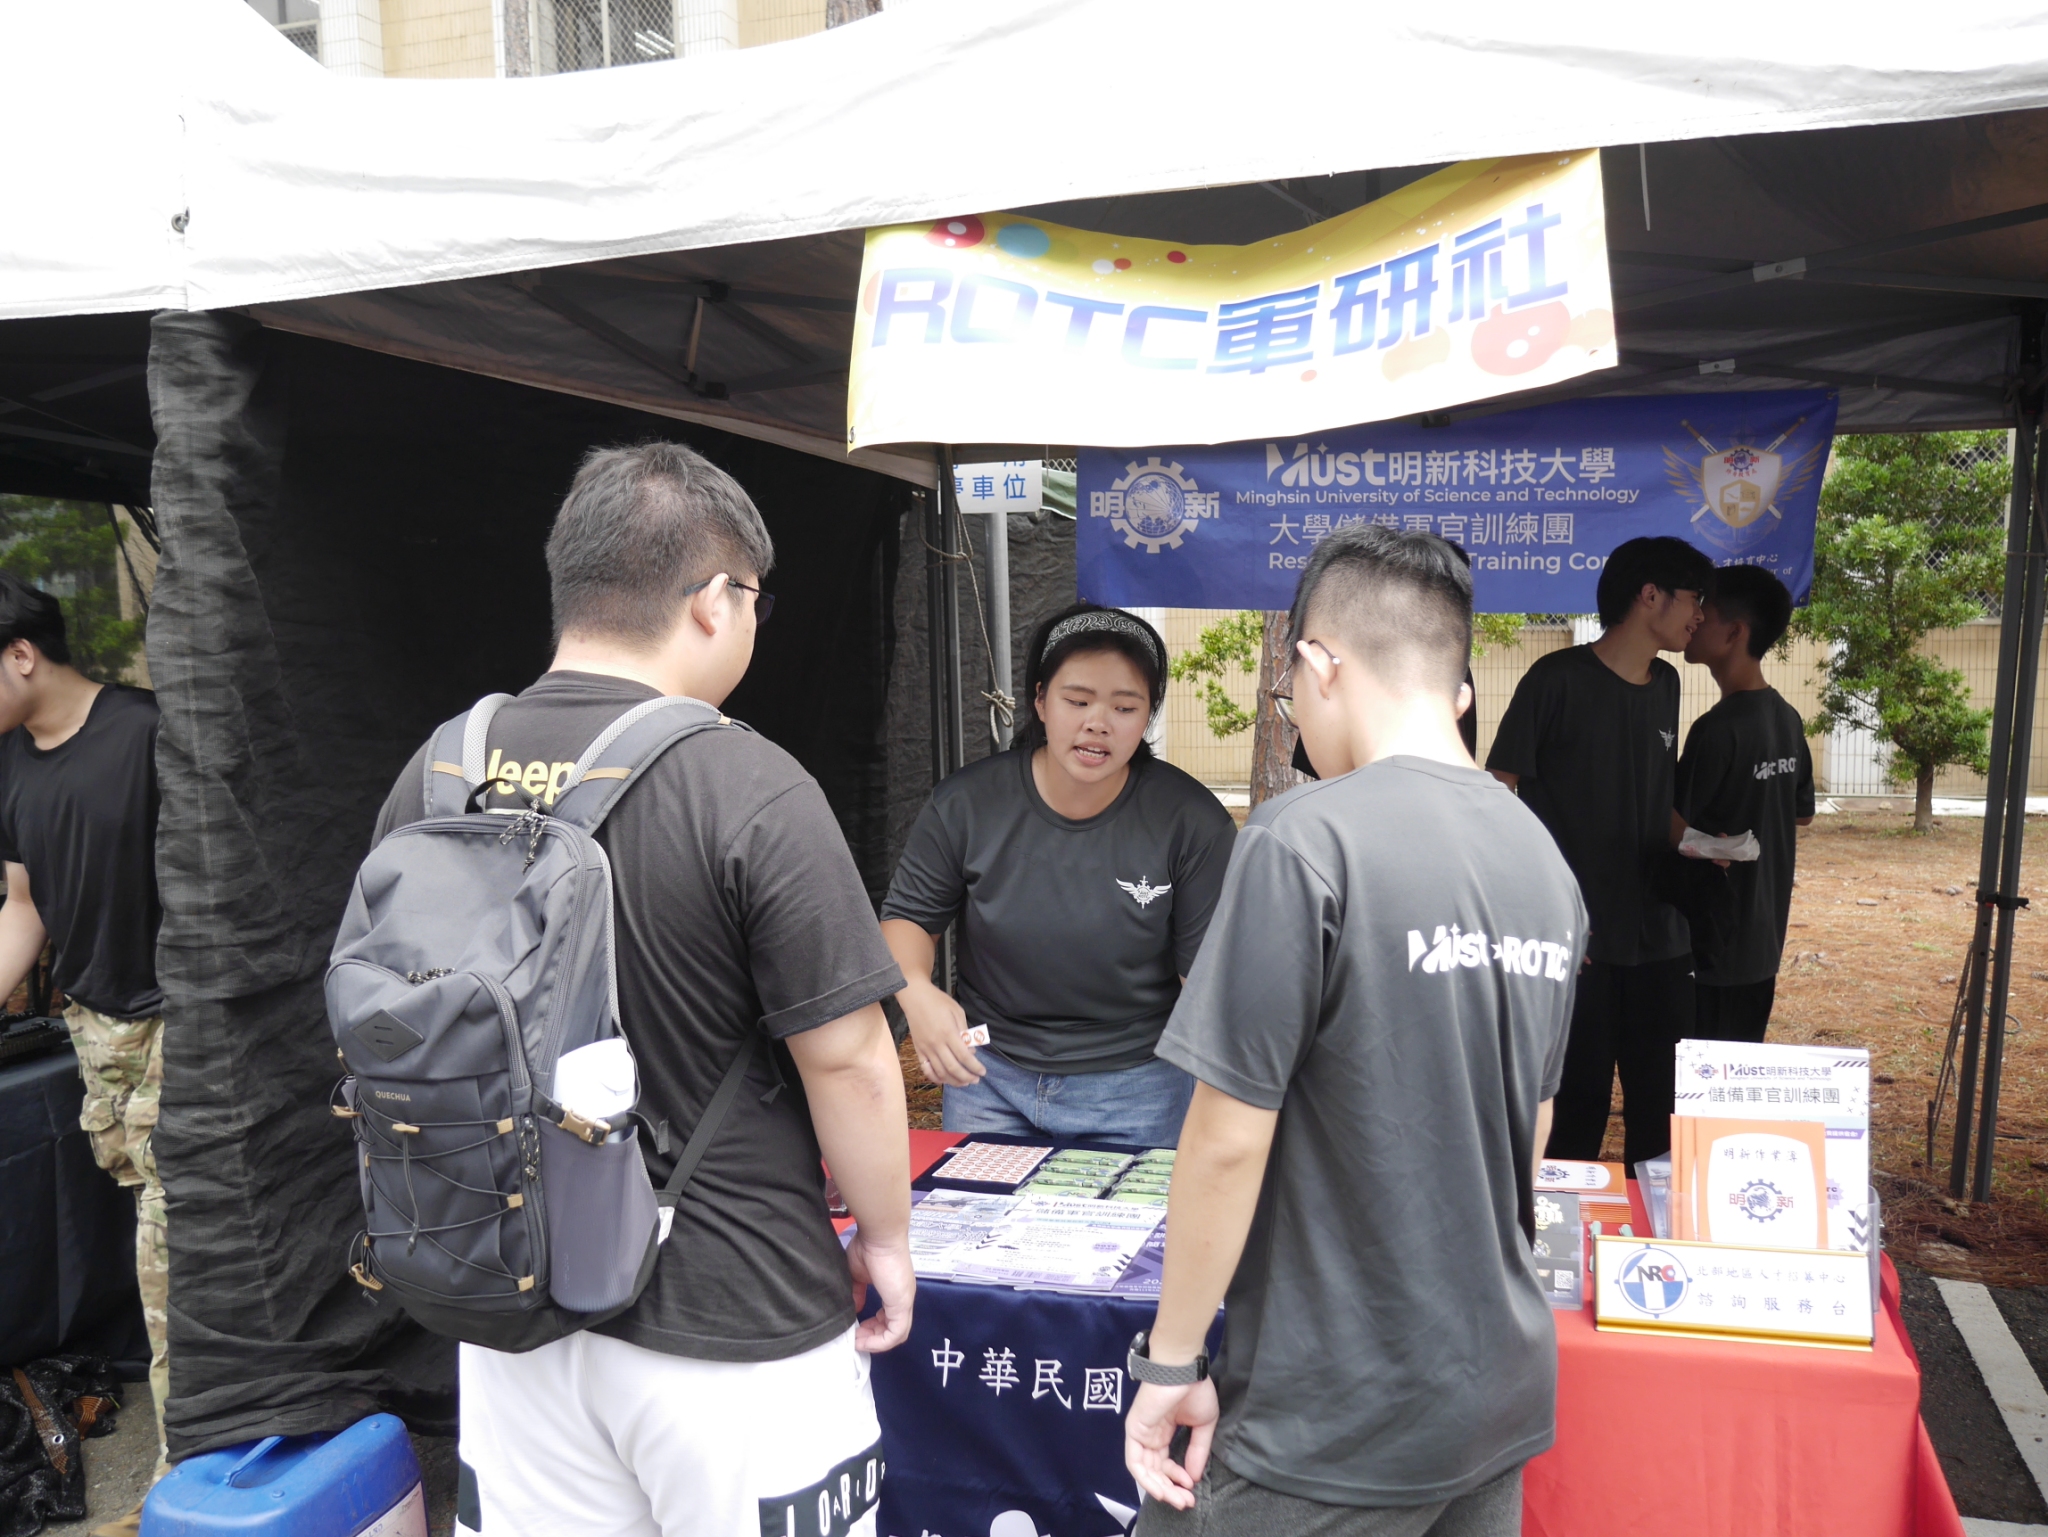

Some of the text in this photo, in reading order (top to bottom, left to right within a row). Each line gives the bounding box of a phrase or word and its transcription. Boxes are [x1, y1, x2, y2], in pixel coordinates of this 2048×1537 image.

[1236, 486, 1640, 507] Minghsin University of Science and Technology
[1269, 552, 1307, 569] Res
[1468, 551, 1561, 574] Training
[1783, 566, 1793, 575] of
[486, 749, 577, 805] Jeep
[1503, 935, 1568, 982] ROTC
[375, 1090, 411, 1102] QUECHUA
[1708, 1086, 1841, 1104] 儲備軍官訓練團
[1637, 1264, 1676, 1282] NRC
[931, 1338, 1124, 1414] 中華民國
